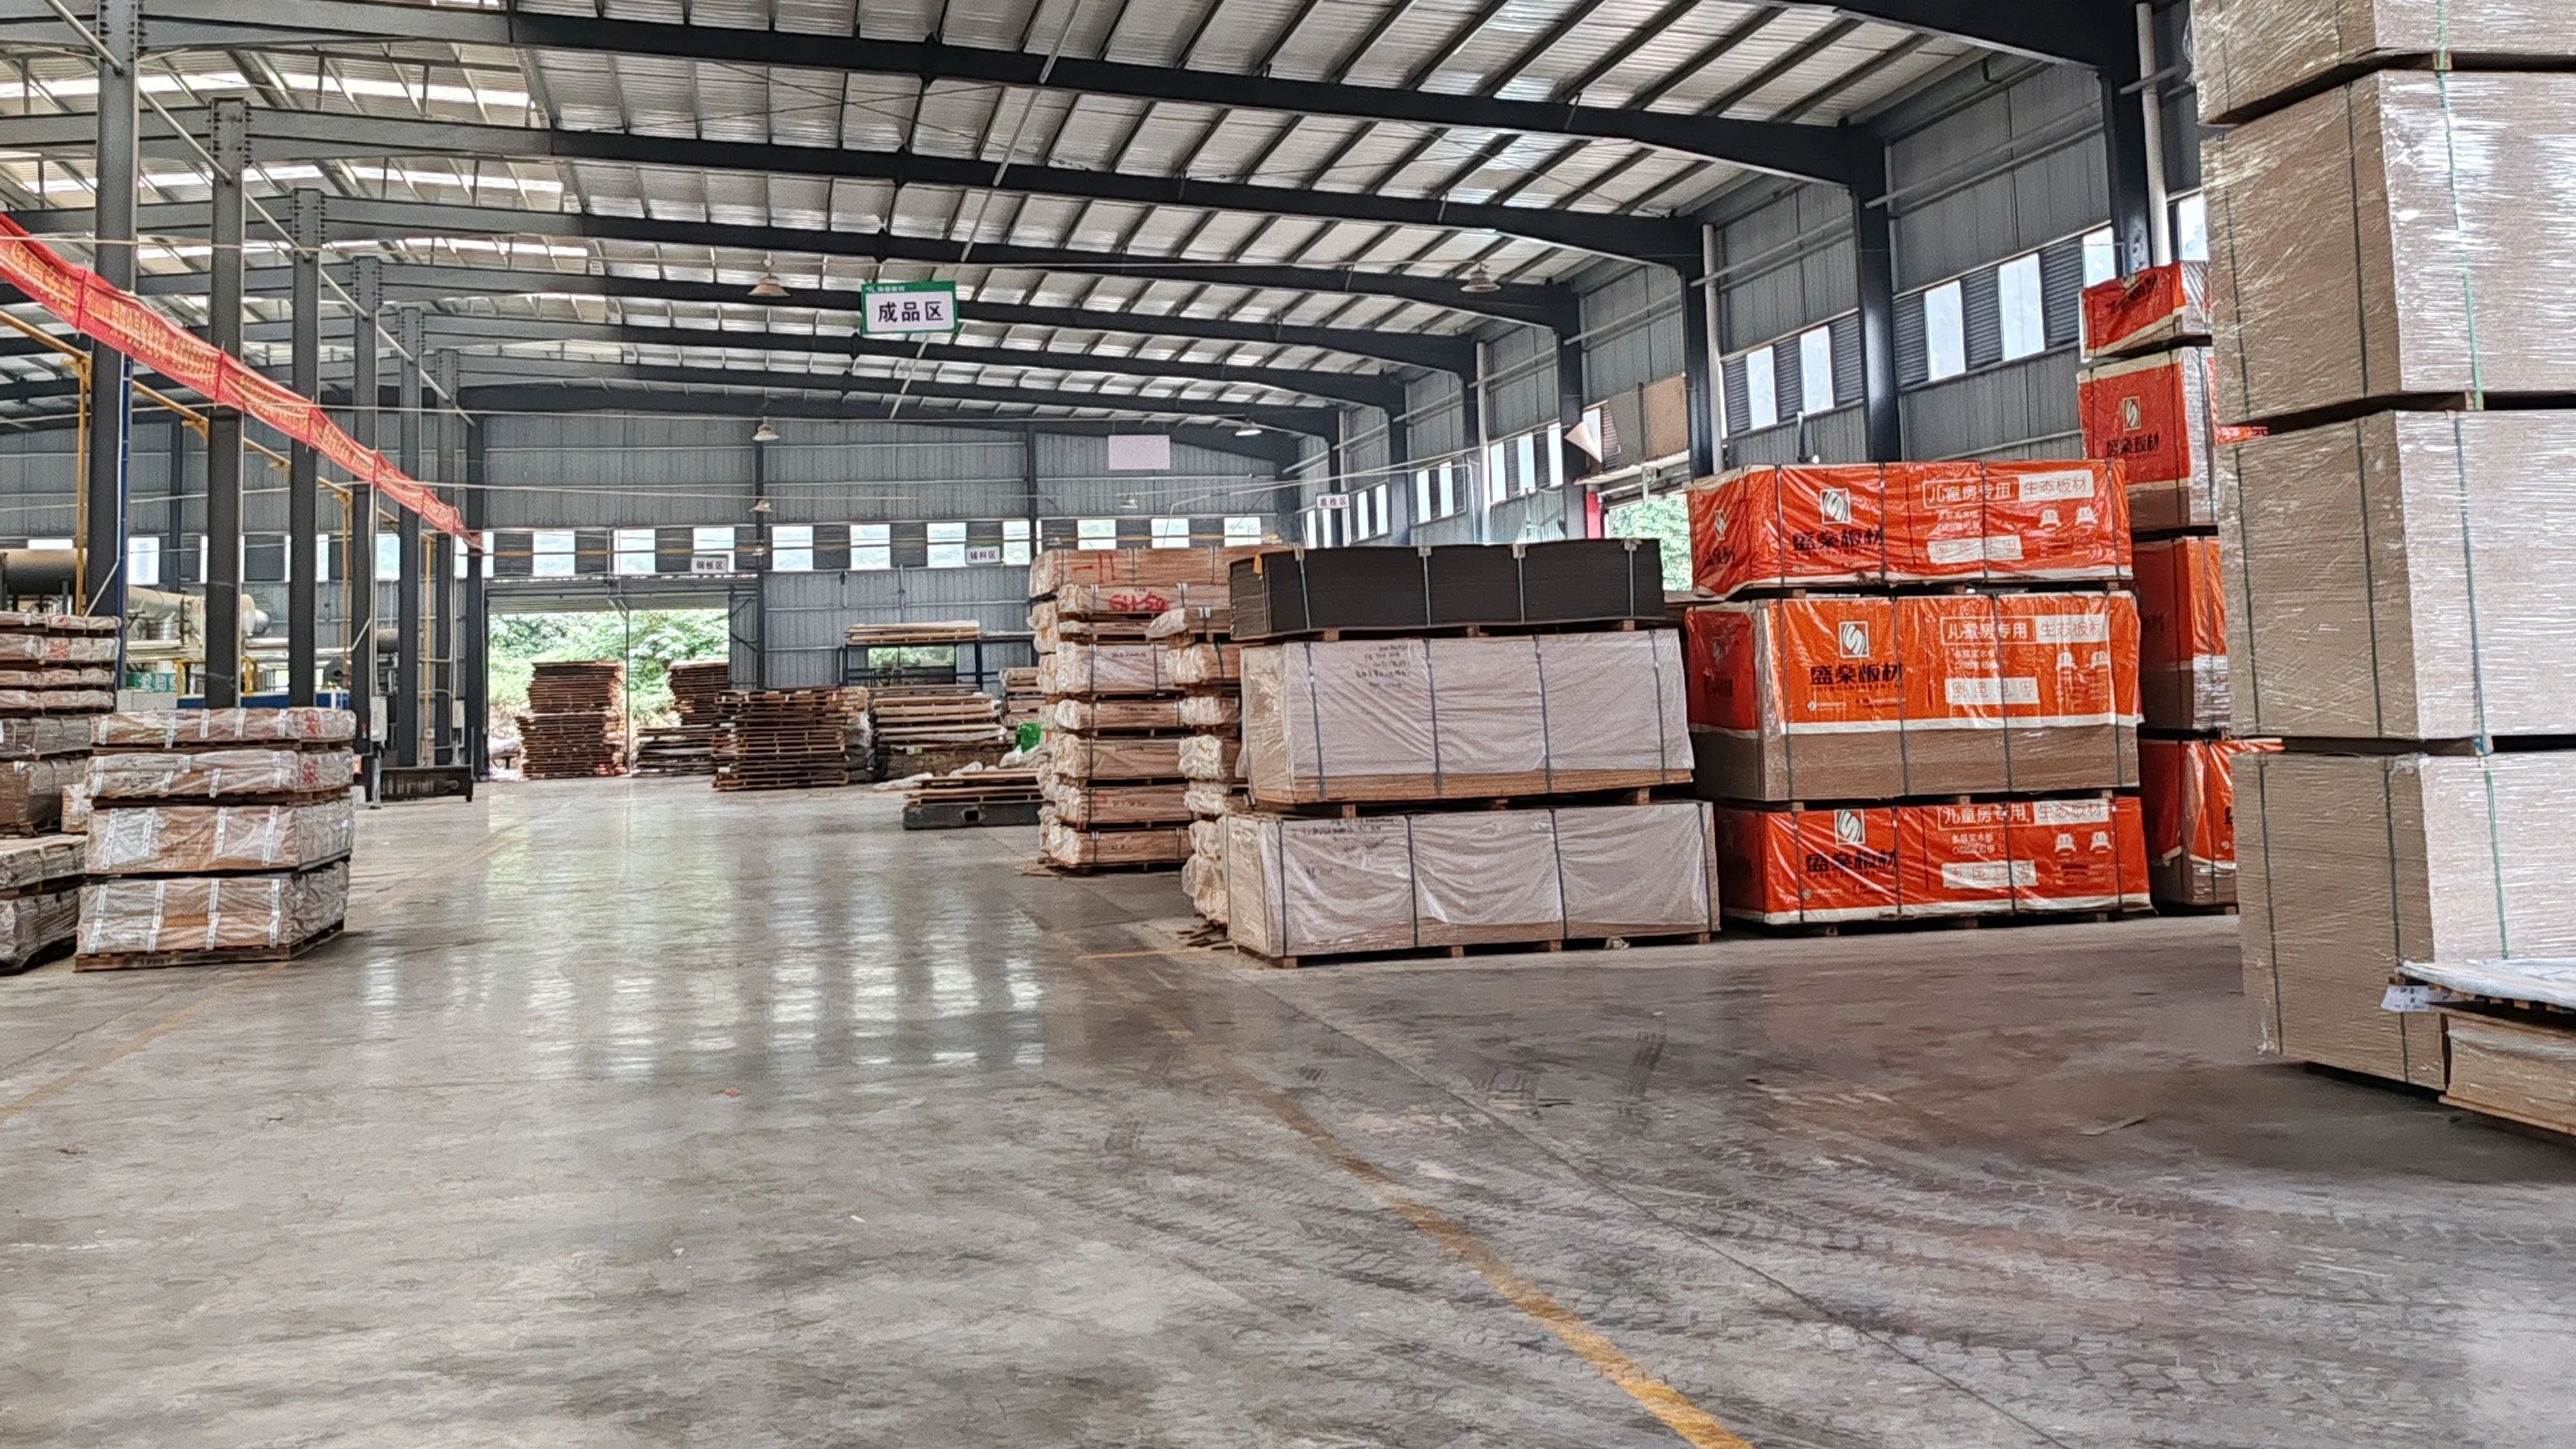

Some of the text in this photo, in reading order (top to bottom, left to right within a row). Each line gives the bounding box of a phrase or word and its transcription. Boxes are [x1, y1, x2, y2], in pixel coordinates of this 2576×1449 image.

[878, 301, 943, 323] 成品区
[1929, 477, 2087, 504] 儿童房专用 生态板材
[1947, 620, 2102, 640] 儿童房专用 生态板材
[1945, 803, 2102, 825] 儿童房专用 生态板材
